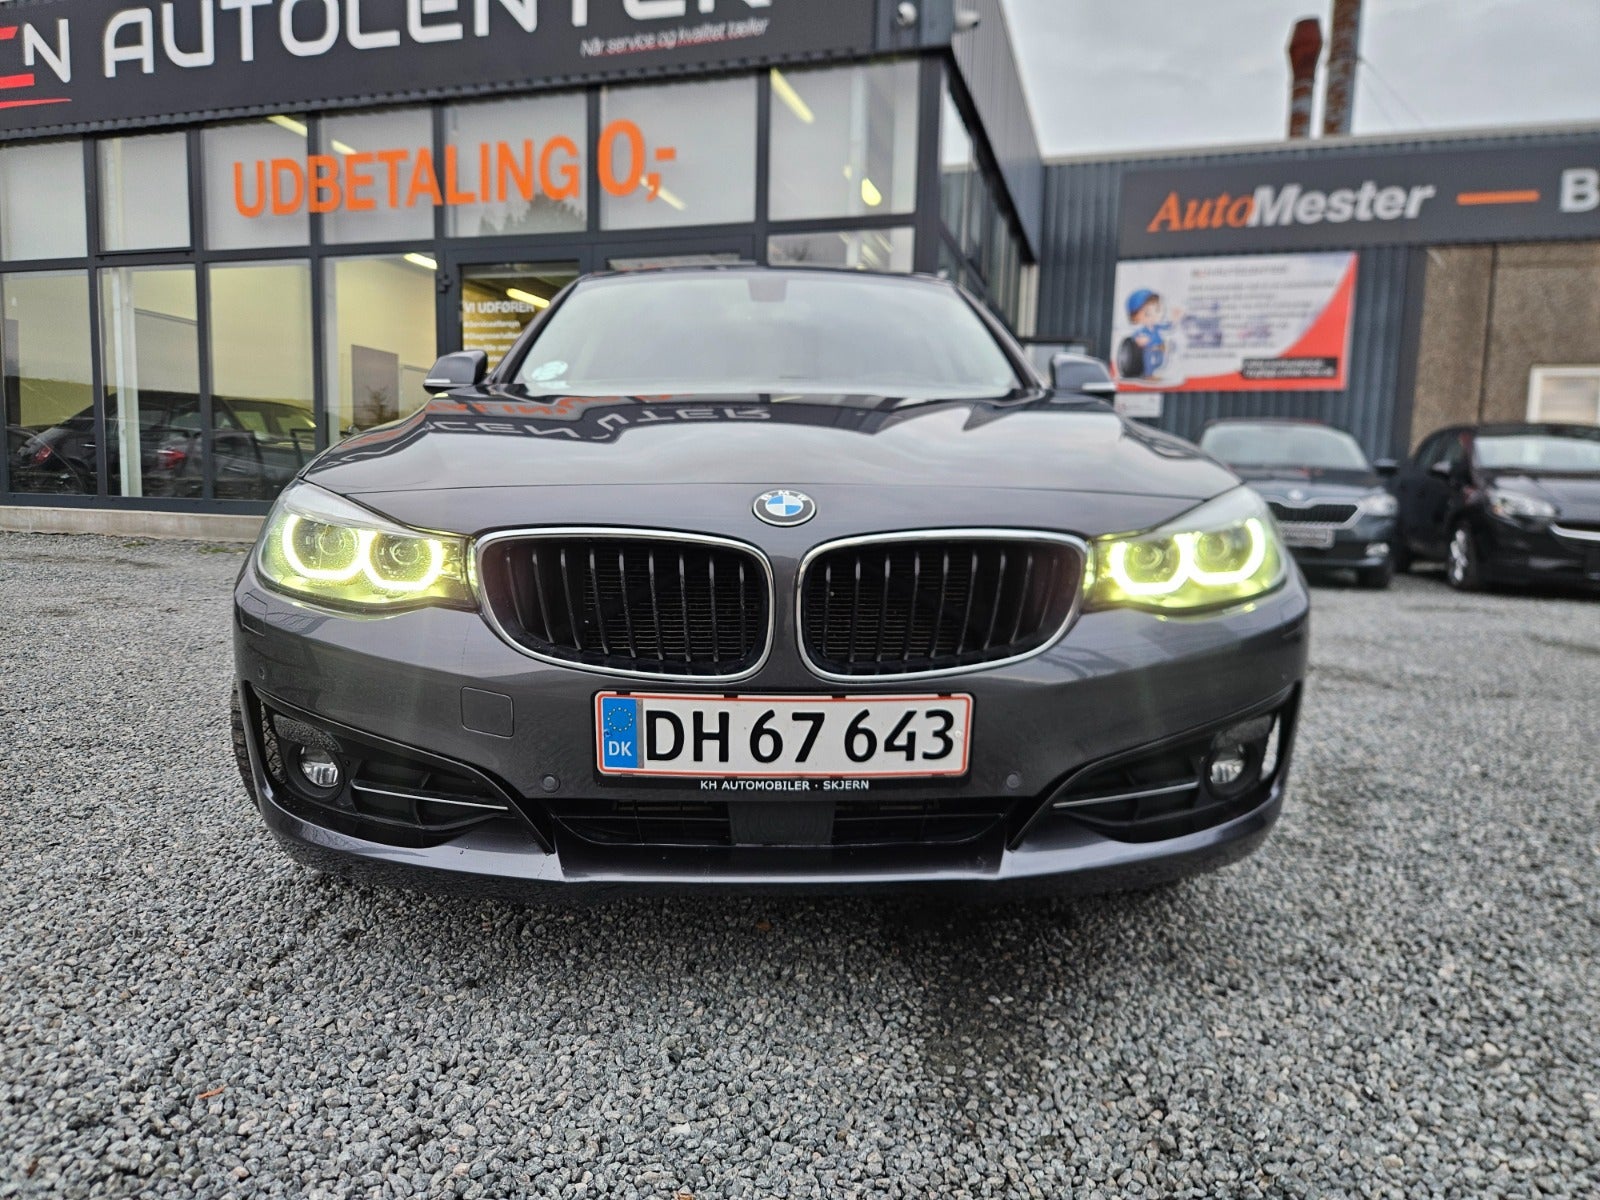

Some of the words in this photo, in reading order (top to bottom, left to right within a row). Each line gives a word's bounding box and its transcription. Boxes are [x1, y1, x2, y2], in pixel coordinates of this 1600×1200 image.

[103, 0, 772, 78] AUTOCEN
[606, 31, 656, 54] service
[657, 29, 677, 49] og
[678, 22, 726, 43] kvalitet
[233, 135, 580, 219] UDBETALING
[608, 740, 633, 757] DK
[646, 710, 730, 763] DH
[749, 708, 826, 764] 67
[844, 708, 955, 763] 643
[700, 780, 718, 790] KH
[721, 780, 810, 791] AUTOMOBILER
[823, 779, 870, 790] SKJERN
